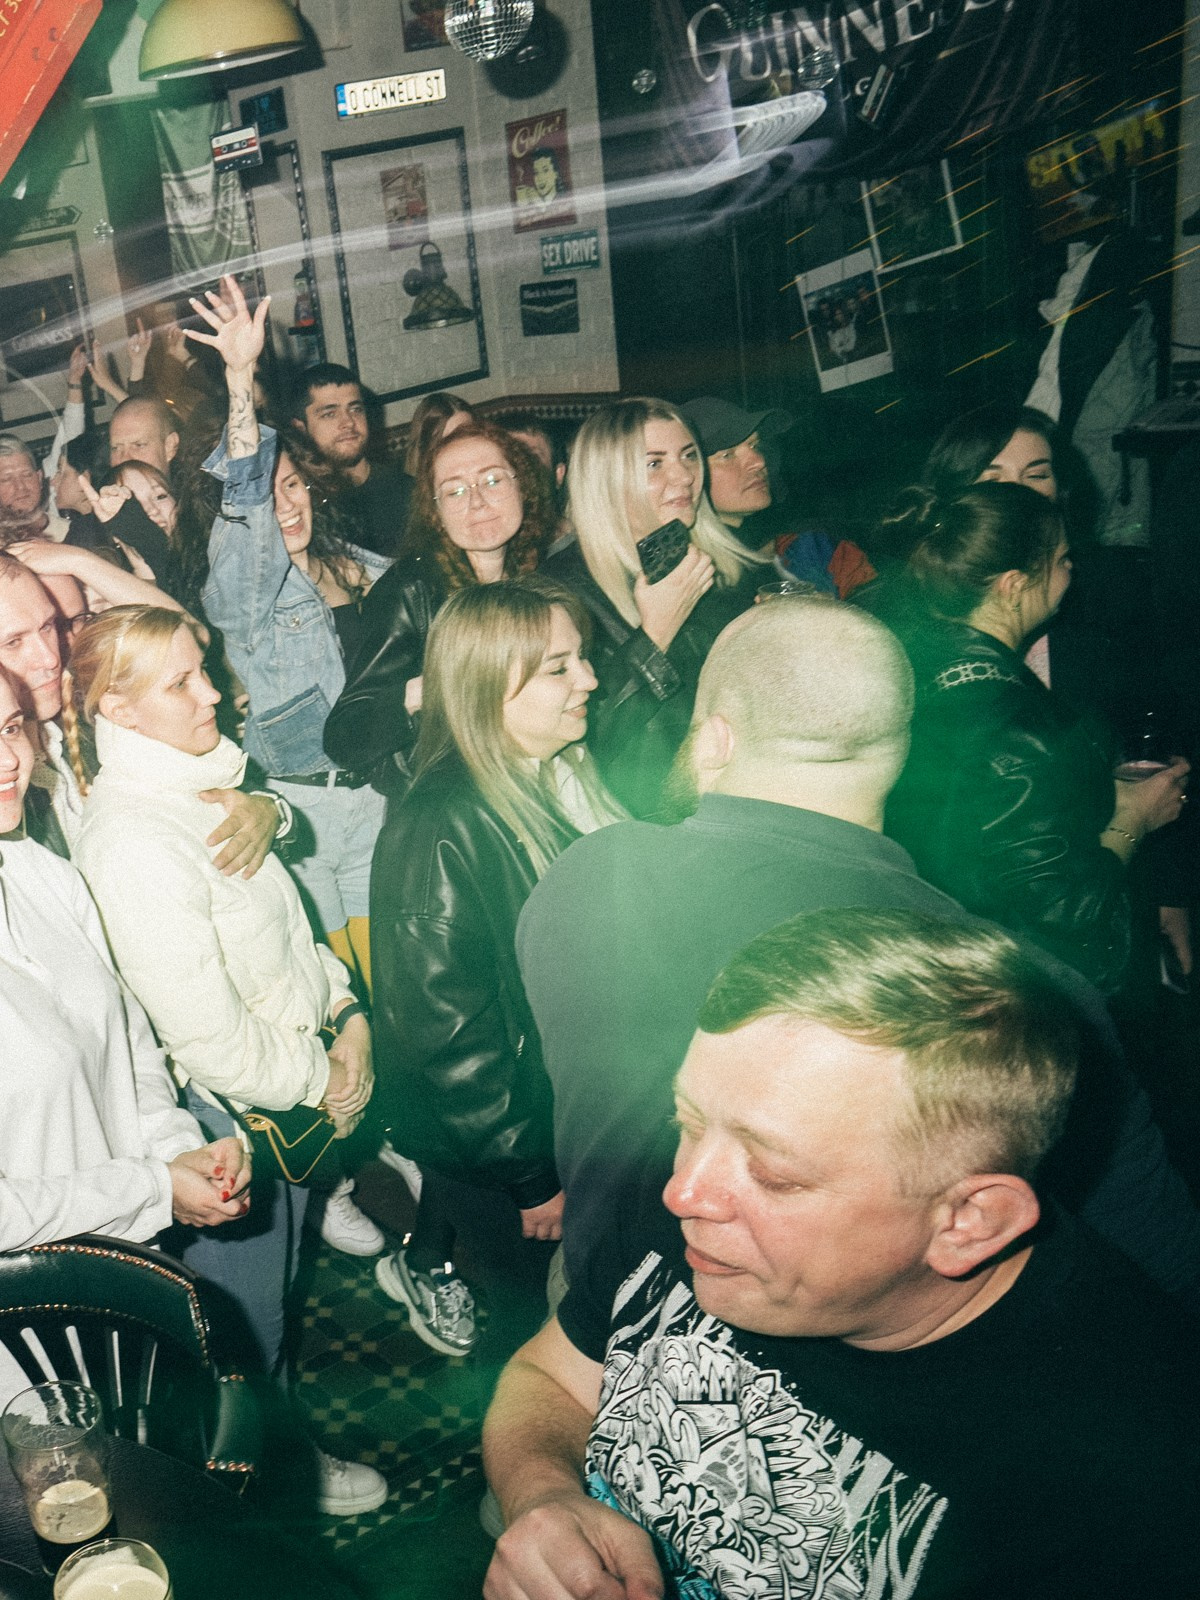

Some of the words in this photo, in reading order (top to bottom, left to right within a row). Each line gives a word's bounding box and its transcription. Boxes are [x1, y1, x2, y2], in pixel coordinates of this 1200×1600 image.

[426, 76, 442, 98] ST
[511, 116, 561, 159] Coffee!
[542, 242, 563, 267] SEX
[563, 236, 598, 265] DRIVE
